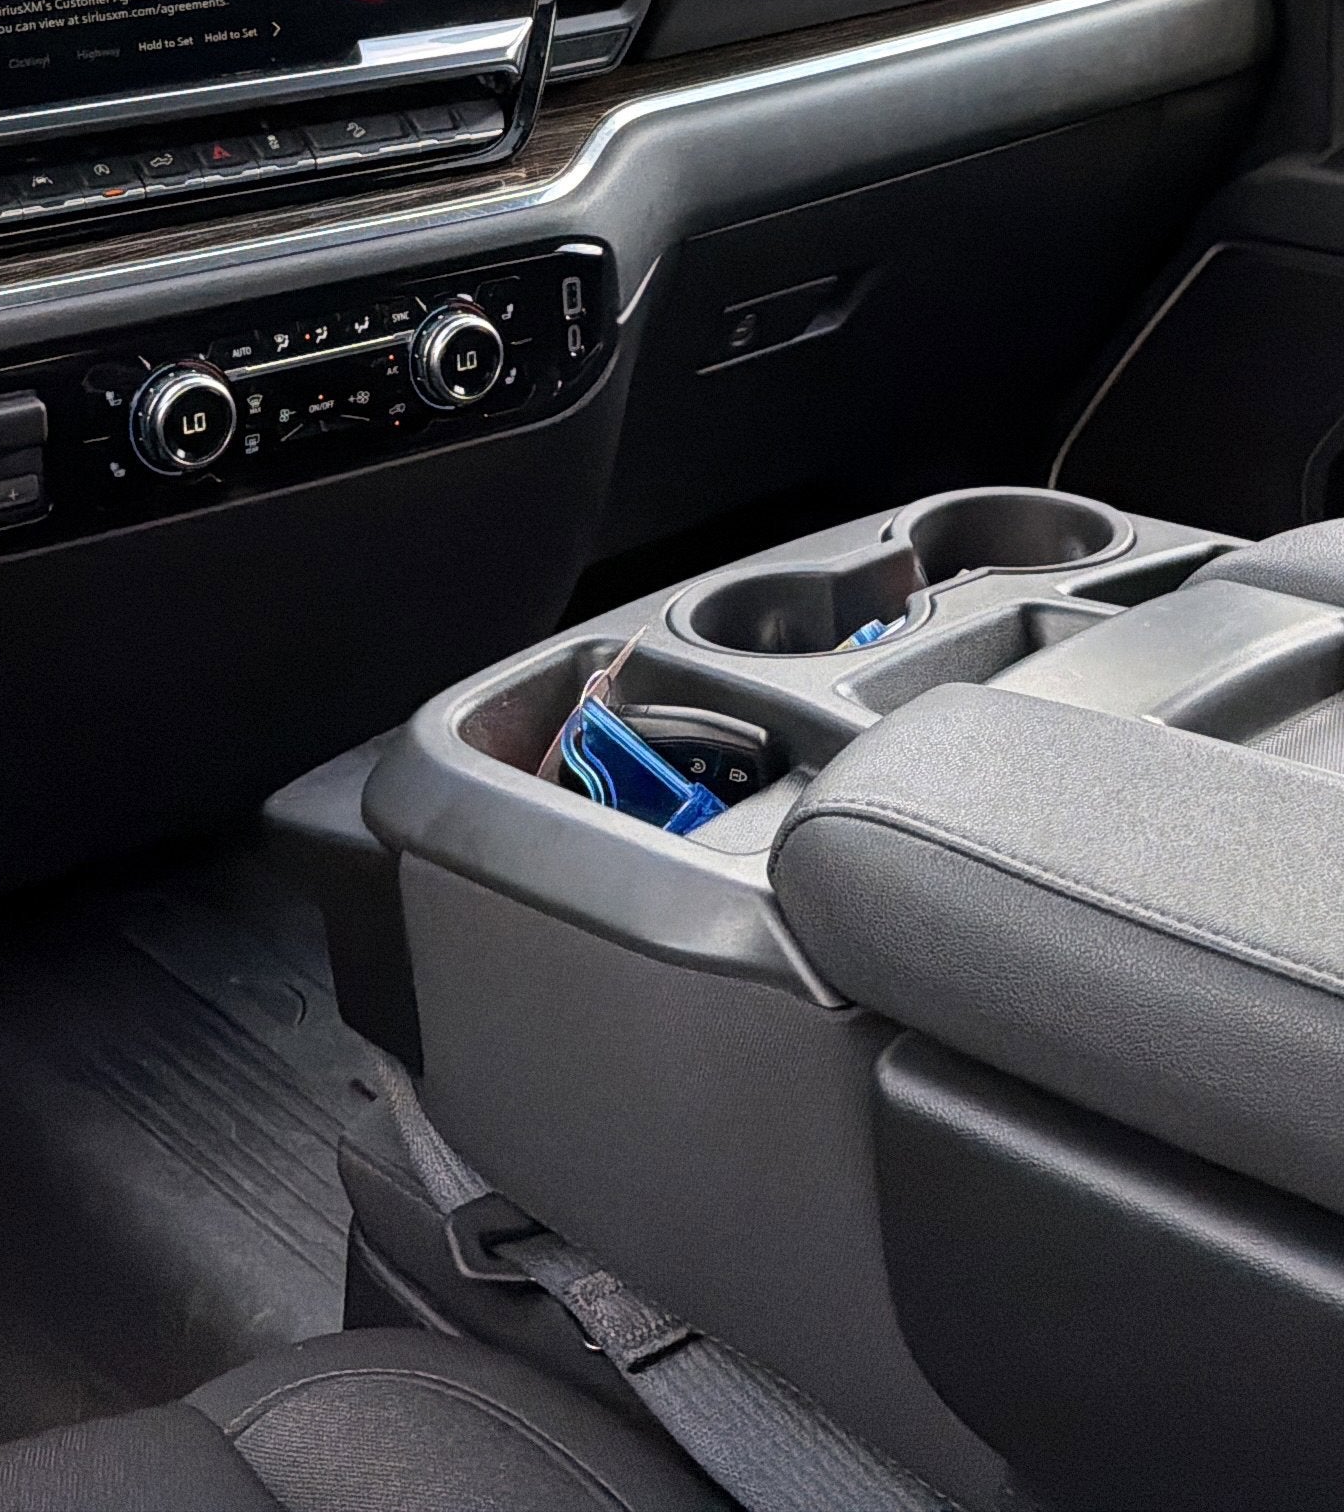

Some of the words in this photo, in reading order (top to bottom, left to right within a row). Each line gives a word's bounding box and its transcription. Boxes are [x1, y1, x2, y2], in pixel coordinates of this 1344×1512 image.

[15, 21, 37, 32] can
[38, 17, 65, 30] view
[67, 14, 80, 26] at
[204, 30, 228, 43] Hold
[229, 29, 241, 39] to
[242, 27, 258, 38] Set
[138, 40, 163, 52] Hold
[164, 38, 176, 48] to
[177, 36, 194, 47] Set
[76, 47, 121, 61] Highway
[391, 310, 410, 323] SYNC
[232, 346, 252, 359] AUTO
[456, 350, 477, 372] LO
[308, 399, 335, 414] ON/OFF
[182, 411, 207, 436] LO
